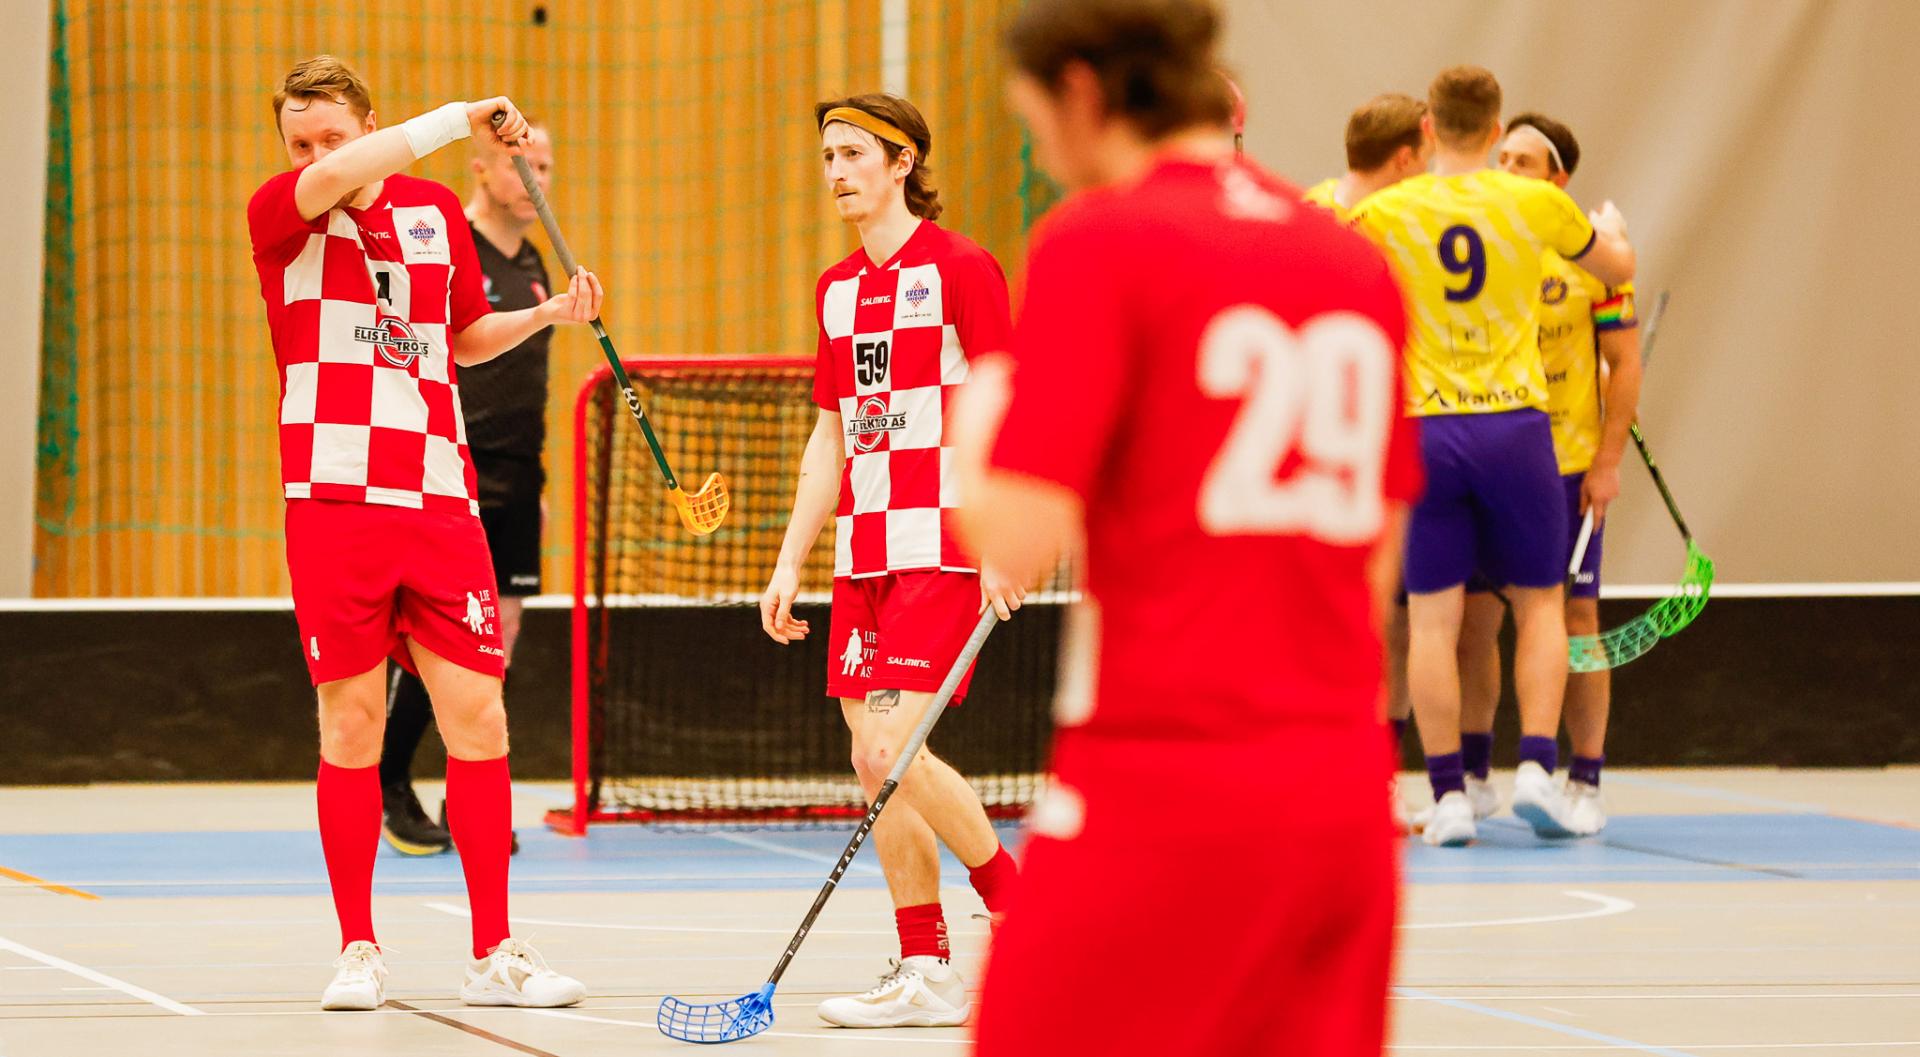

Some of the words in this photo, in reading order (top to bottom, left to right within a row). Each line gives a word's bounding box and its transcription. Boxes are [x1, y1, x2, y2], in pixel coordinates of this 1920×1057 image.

[1437, 224, 1487, 303] 9
[354, 329, 379, 341] ELIS
[856, 340, 889, 386] 59
[1458, 386, 1530, 404] kanso
[891, 416, 906, 427] AS
[1197, 303, 1396, 546] 29
[865, 630, 877, 644] LIE
[310, 636, 321, 660] 4
[860, 665, 873, 678] AS
[837, 801, 884, 875] SALMING
